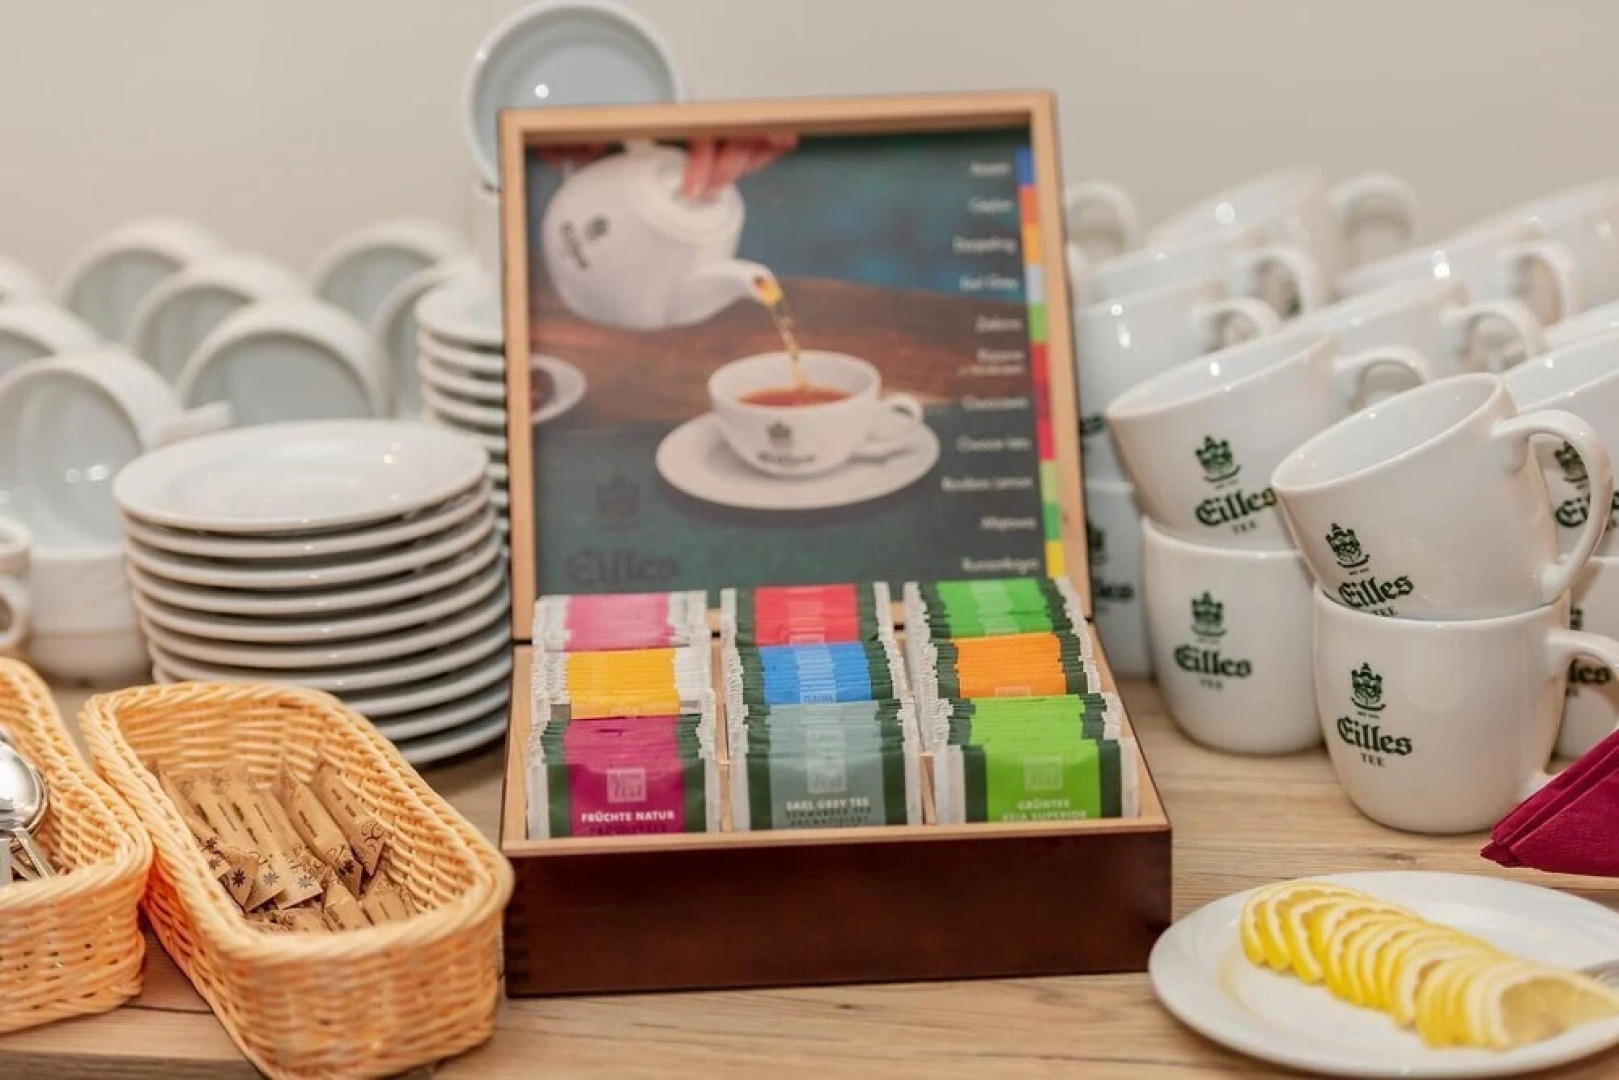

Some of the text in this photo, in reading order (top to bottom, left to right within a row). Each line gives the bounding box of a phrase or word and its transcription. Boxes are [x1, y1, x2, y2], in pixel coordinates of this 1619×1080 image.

[1338, 576, 1414, 608] Eilles
[1336, 716, 1413, 756] Eilles
[1360, 752, 1386, 768] TEE
[786, 801, 813, 811] EARL
[817, 799, 847, 810] GREY
[581, 810, 675, 823] FRÜCHTE NATUR
